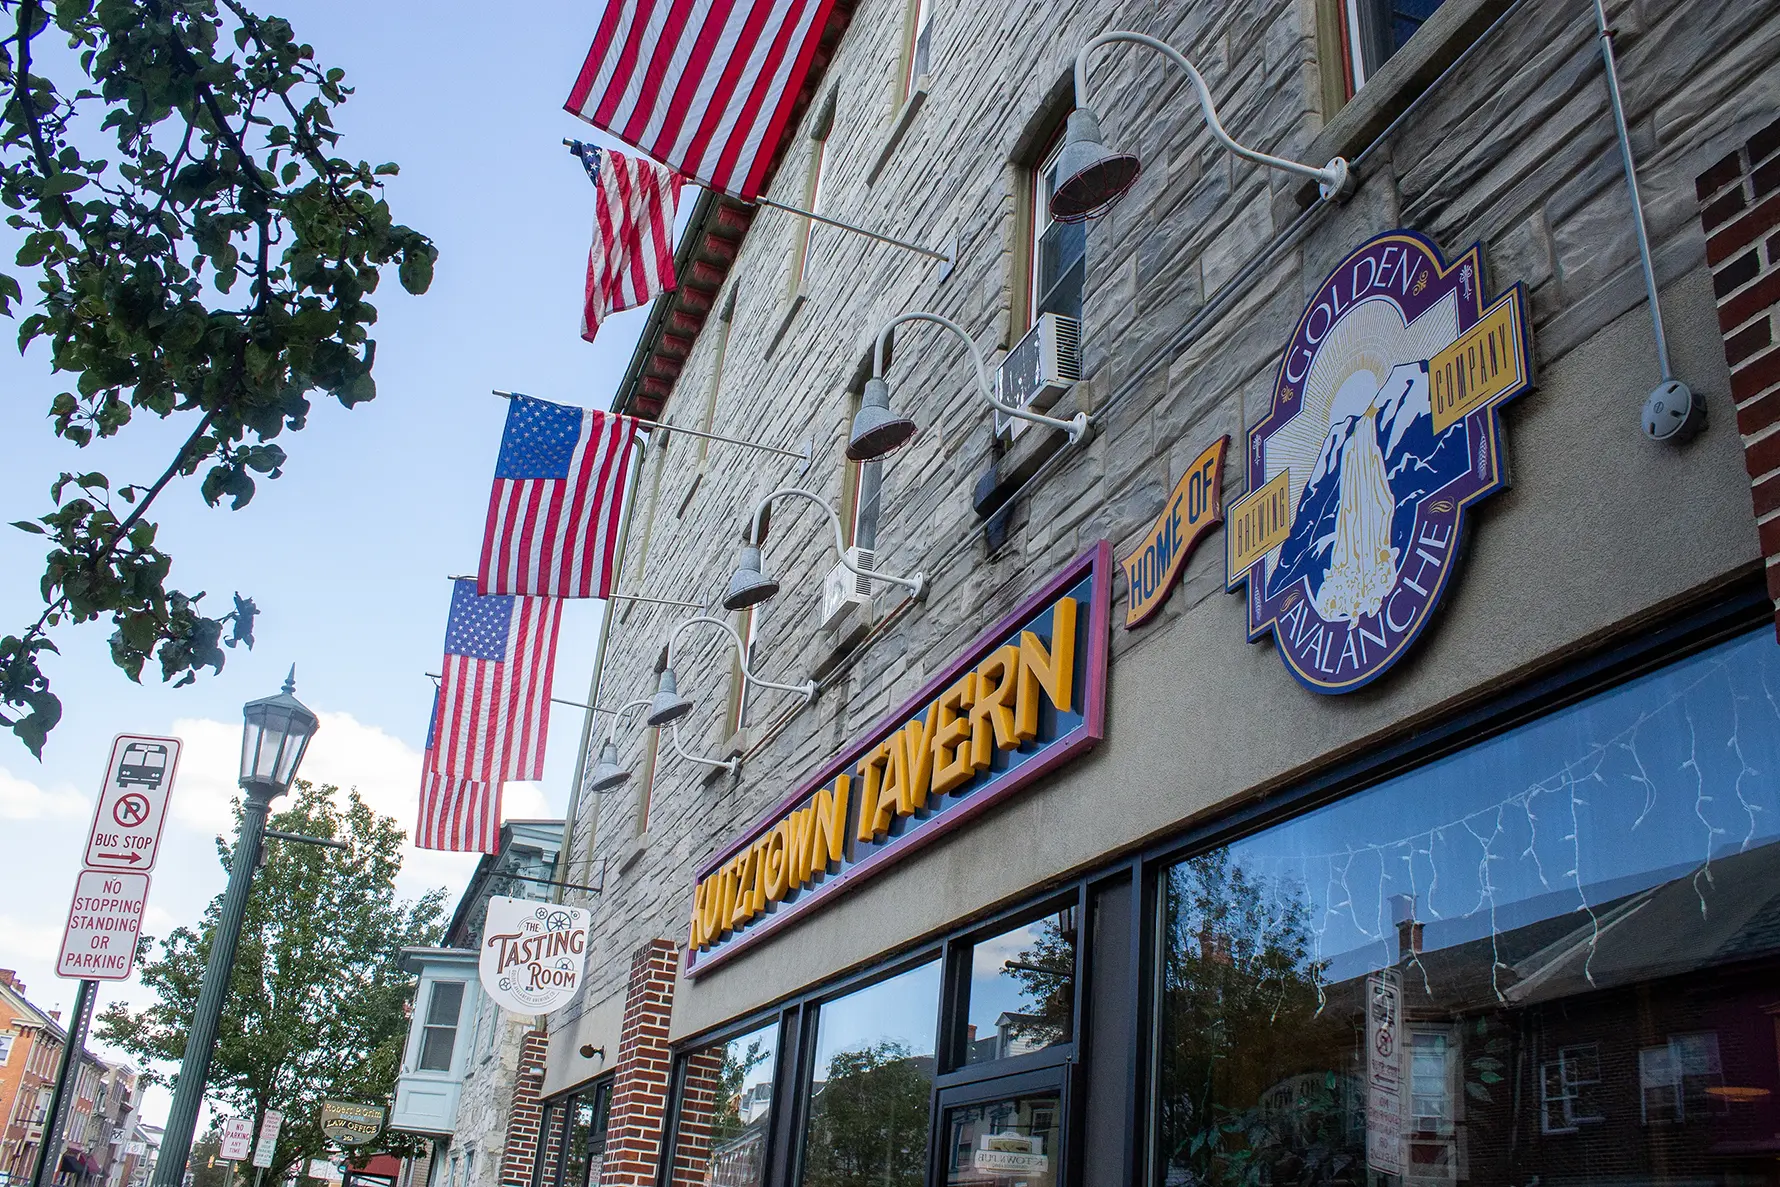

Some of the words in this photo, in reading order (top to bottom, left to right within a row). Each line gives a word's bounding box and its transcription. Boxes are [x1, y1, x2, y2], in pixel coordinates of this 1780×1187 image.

[1287, 247, 1422, 385] GOLDEN
[1435, 324, 1508, 415] COMPANY
[1130, 488, 1185, 610] HOME
[1188, 459, 1214, 526] OF
[1237, 497, 1288, 558] BREWING
[1279, 522, 1451, 675] AVALANCHE
[689, 774, 850, 951] KUTZTOWN
[857, 597, 1078, 843] TAVERN
[95, 833, 119, 848] BUS
[123, 835, 153, 850] STOP
[103, 880, 122, 894] NO
[75, 897, 142, 914] STOPPING
[70, 915, 137, 932] STANDING
[525, 921, 541, 933] THE
[90, 935, 110, 950] OR
[487, 929, 585, 975] TASTING
[65, 952, 126, 970] PARKING
[527, 961, 576, 990] ROOM
[235, 1123, 245, 1131] NO
[326, 1119, 347, 1128] LAW
[347, 1121, 378, 1134] OFFICE
[226, 1130, 250, 1141] PARKING
